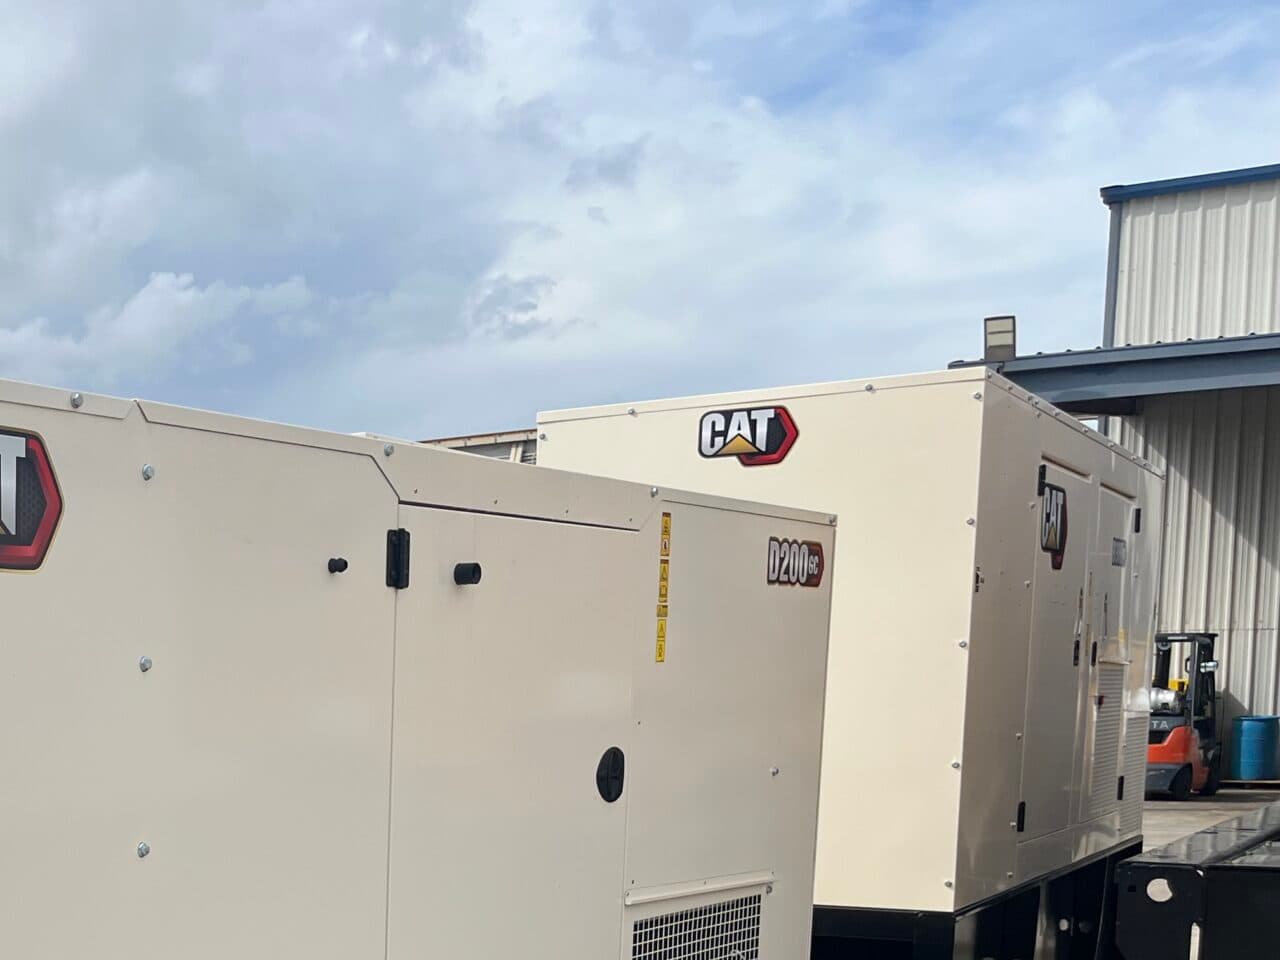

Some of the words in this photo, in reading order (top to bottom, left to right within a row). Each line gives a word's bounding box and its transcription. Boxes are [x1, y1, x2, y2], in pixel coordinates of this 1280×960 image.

[701, 408, 774, 455] CAT
[1043, 486, 1064, 549] CAT
[769, 541, 809, 583] D200
